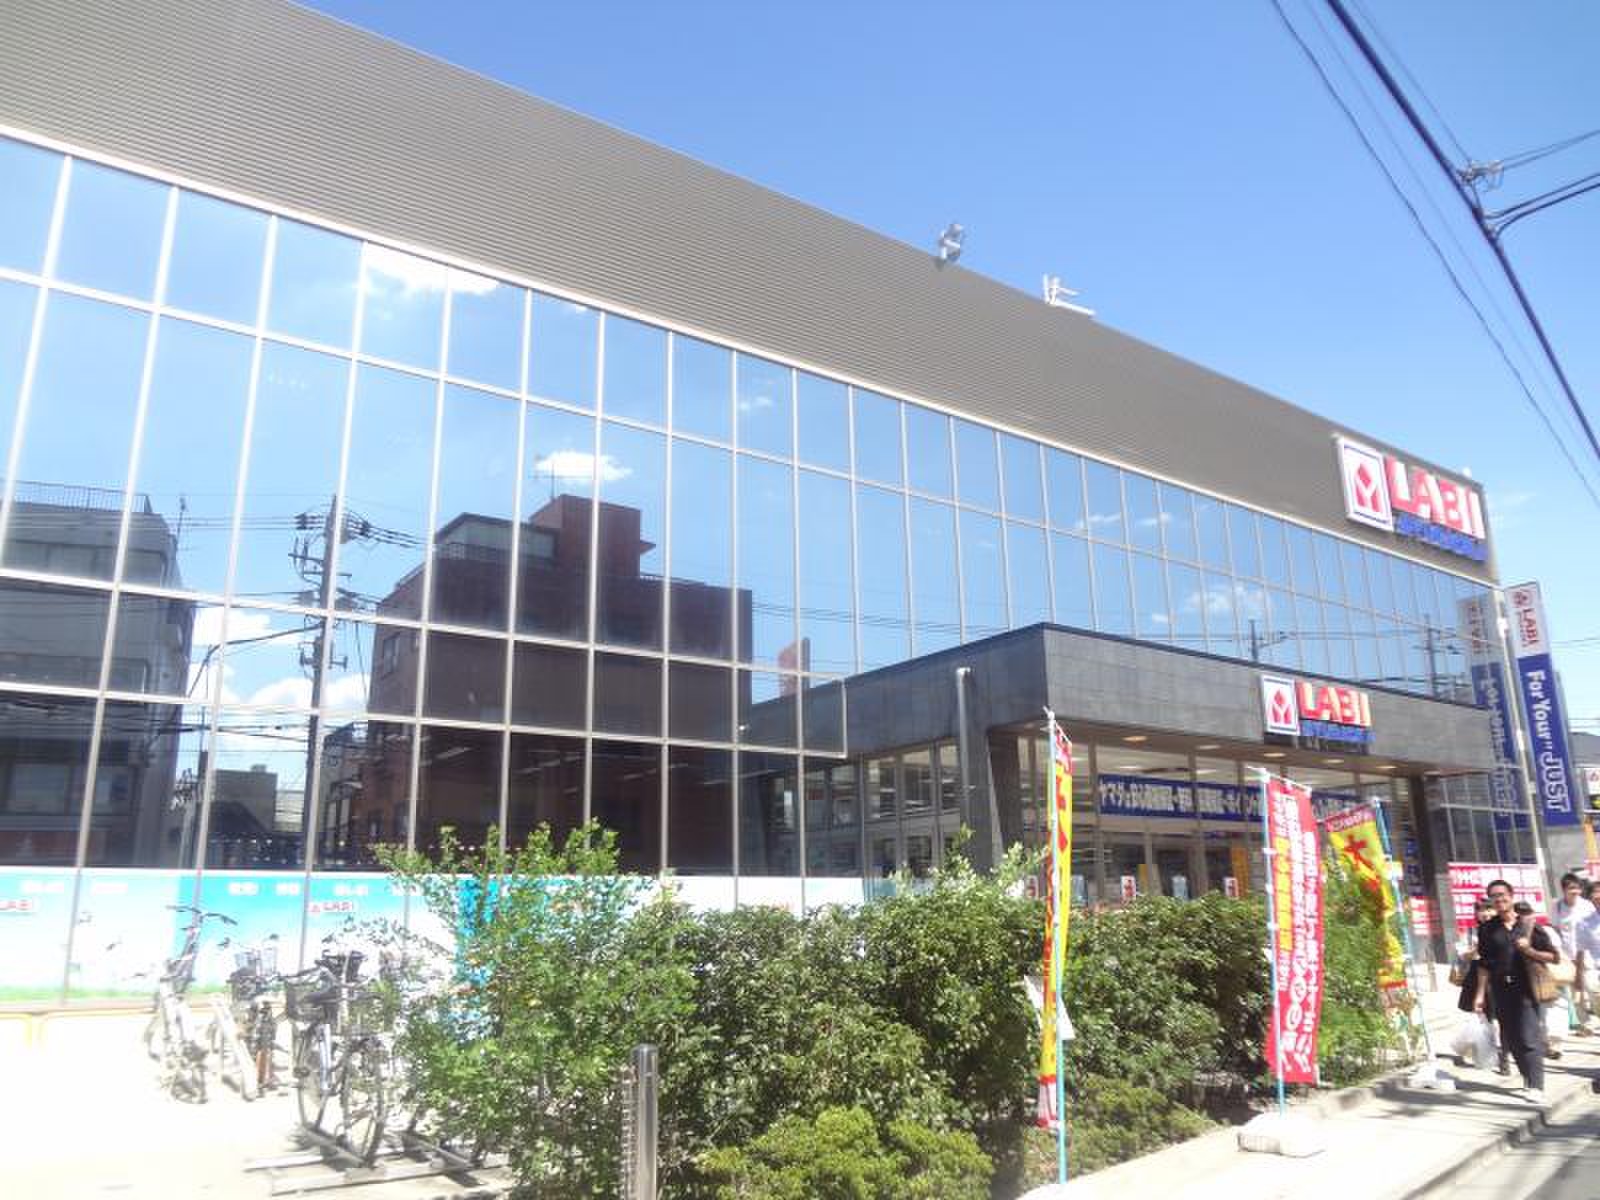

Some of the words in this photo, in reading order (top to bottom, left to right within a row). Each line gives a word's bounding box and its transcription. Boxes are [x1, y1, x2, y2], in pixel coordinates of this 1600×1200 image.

[1386, 455, 1485, 539] LABI
[1523, 607, 1541, 646] LABI
[1296, 682, 1371, 727] LABI
[1526, 669, 1546, 698] For
